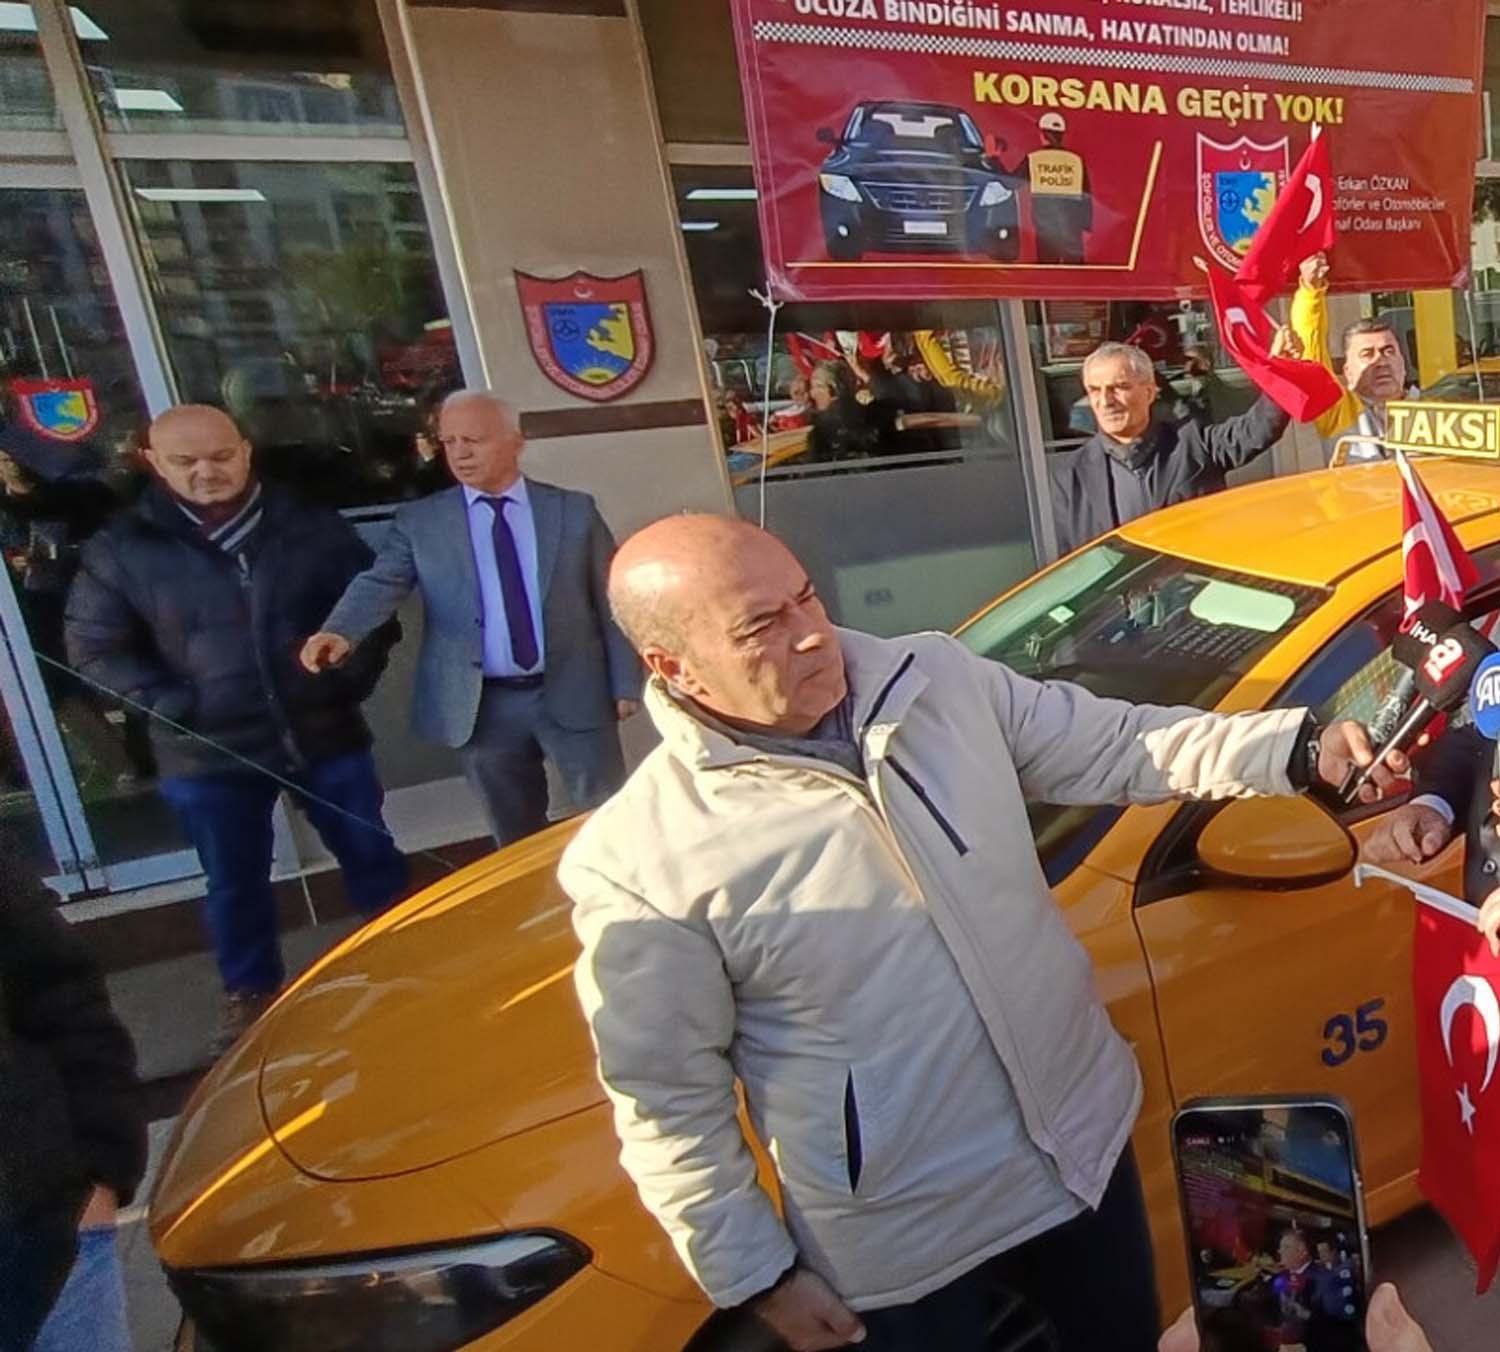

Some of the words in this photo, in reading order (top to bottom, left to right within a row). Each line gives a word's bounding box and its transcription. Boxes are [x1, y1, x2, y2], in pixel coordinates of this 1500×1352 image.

[795, 0, 878, 19] UCUZA
[1006, 10, 1095, 41] SANMA,
[1101, 19, 1232, 50] HAYATINDAN
[1237, 32, 1289, 56] OLMA!
[973, 71, 1168, 115] KORSANA
[1177, 84, 1268, 127] GEÇİT
[1274, 94, 1344, 123] YOK!
[1370, 174, 1408, 190] ÖZKAN
[1321, 998, 1387, 1066] 35
